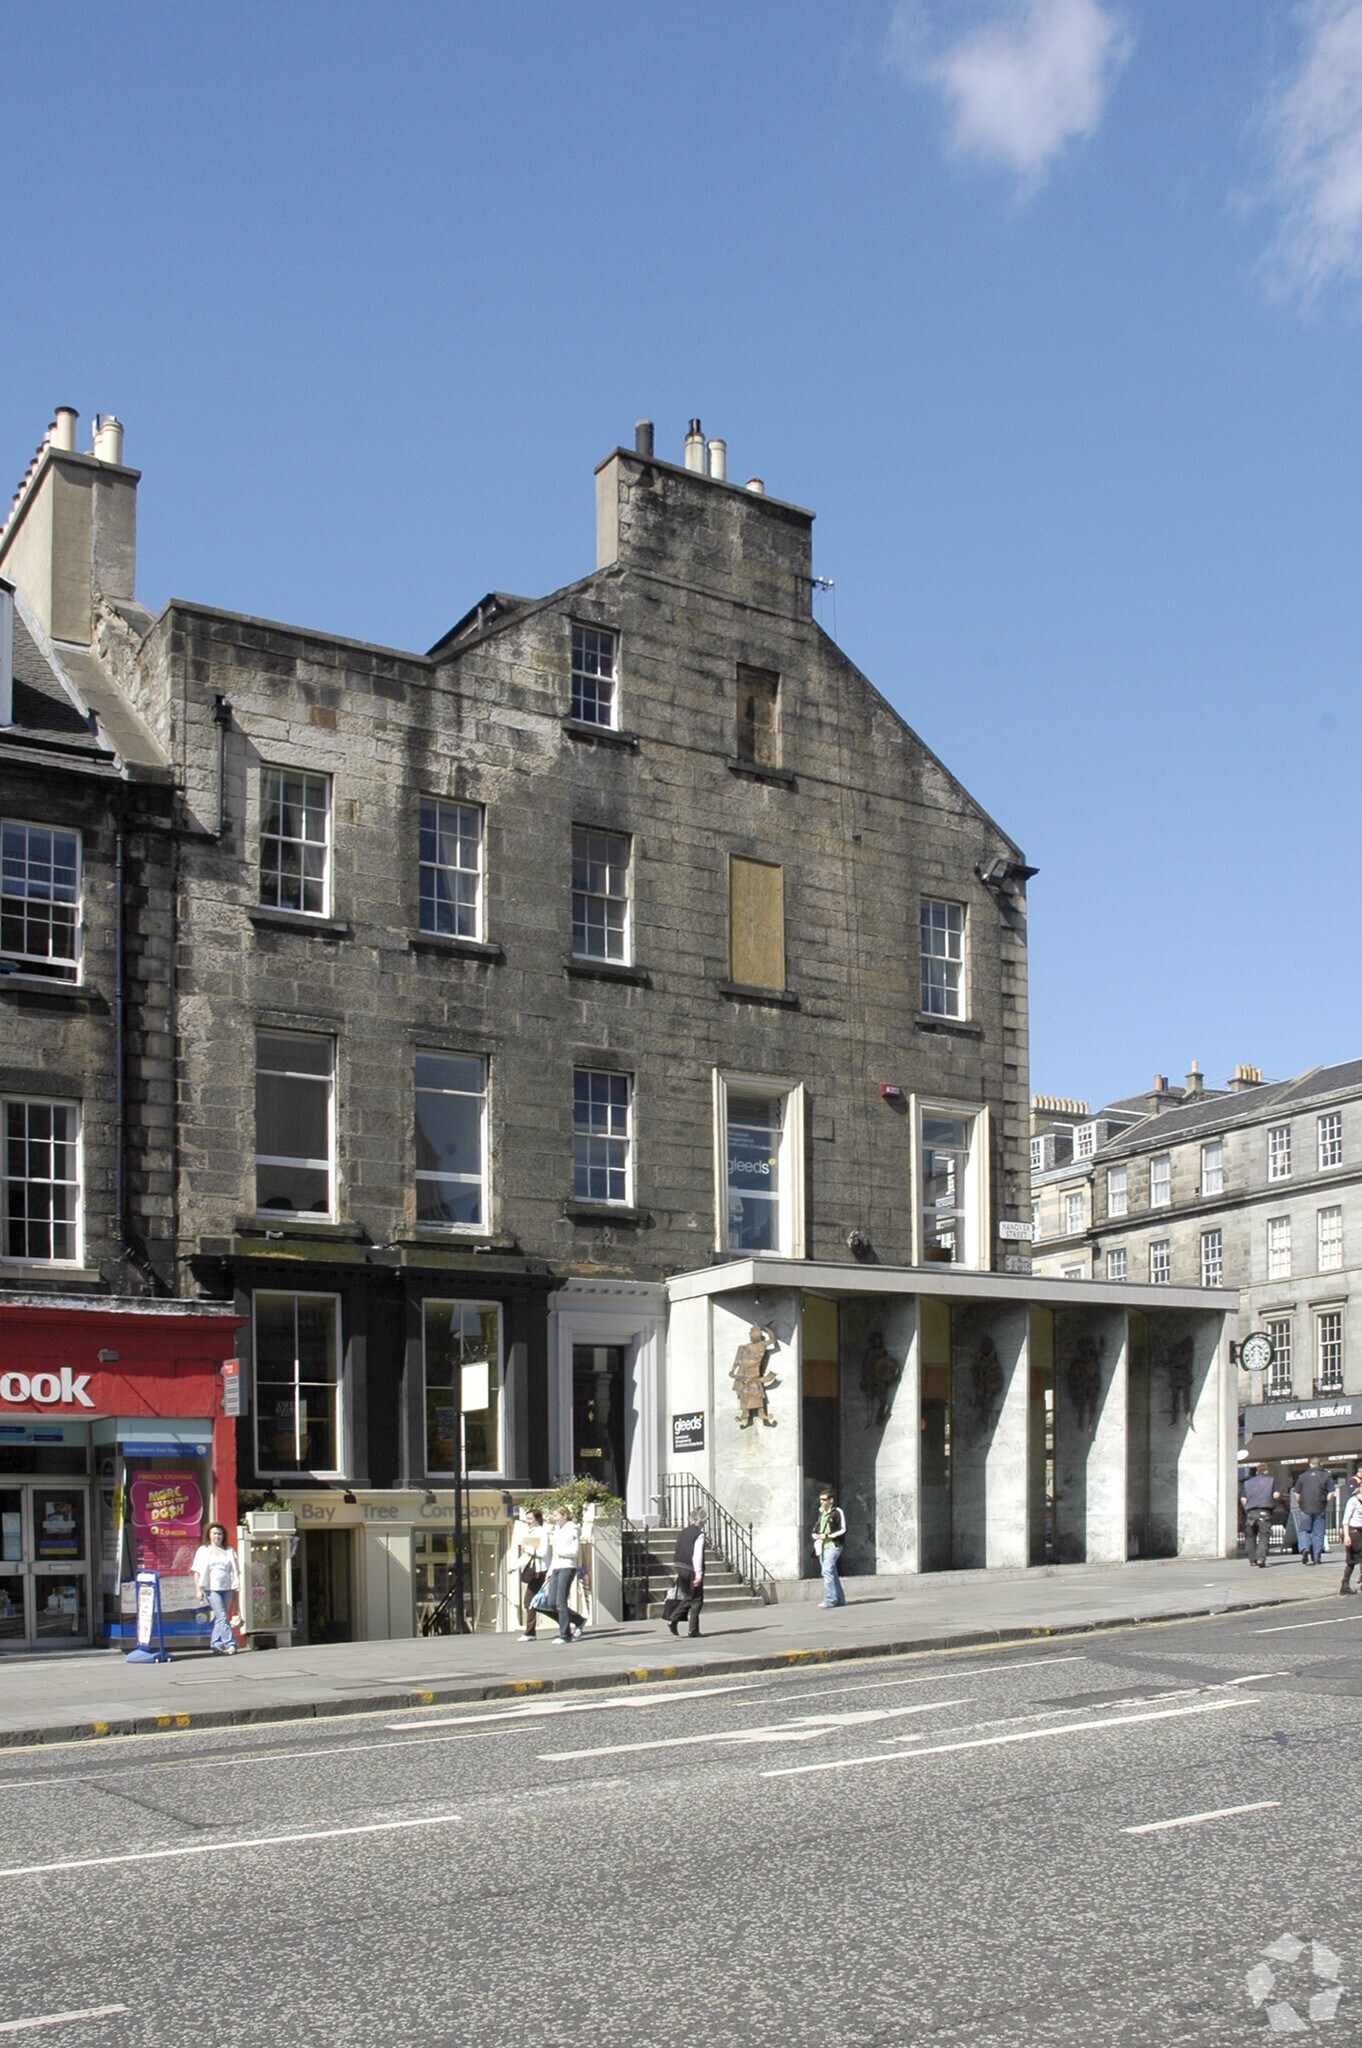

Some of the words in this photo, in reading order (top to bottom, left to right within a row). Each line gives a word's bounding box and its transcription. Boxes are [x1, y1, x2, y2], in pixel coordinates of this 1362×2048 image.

[727, 1157, 769, 1175] gleeds
[0, 1366, 96, 1407] ook
[675, 1416, 702, 1435] gleeds
[148, 1486, 181, 1502] MORE
[301, 1503, 336, 1522] Bay
[361, 1503, 399, 1519] Tree
